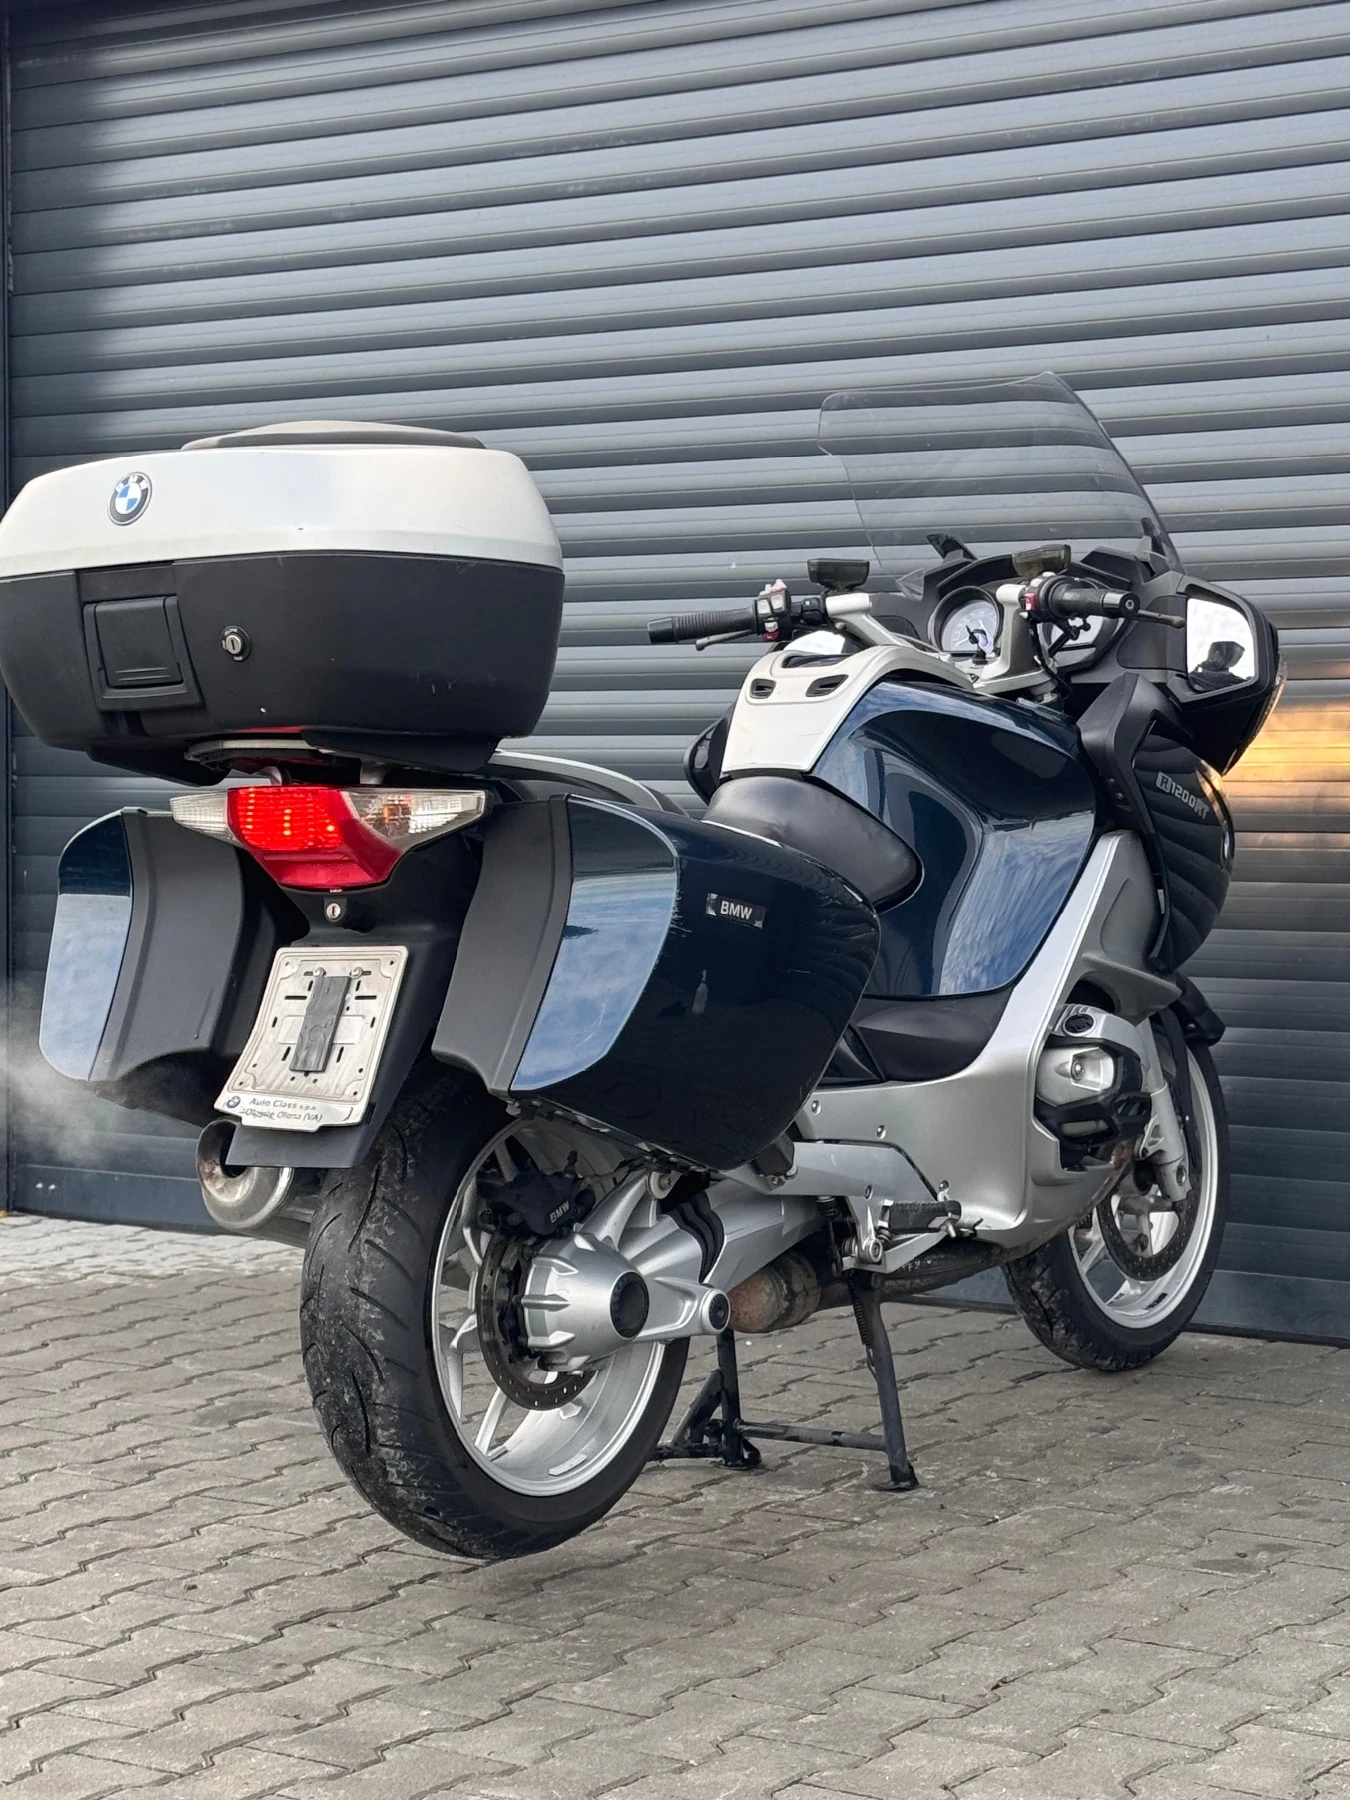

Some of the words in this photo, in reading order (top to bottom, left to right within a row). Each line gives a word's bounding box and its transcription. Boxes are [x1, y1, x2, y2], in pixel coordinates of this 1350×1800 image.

[720, 900, 753, 920] BMW
[249, 1097, 271, 1108] Auto
[273, 1099, 297, 1109] Class
[550, 1200, 570, 1224] BMW
